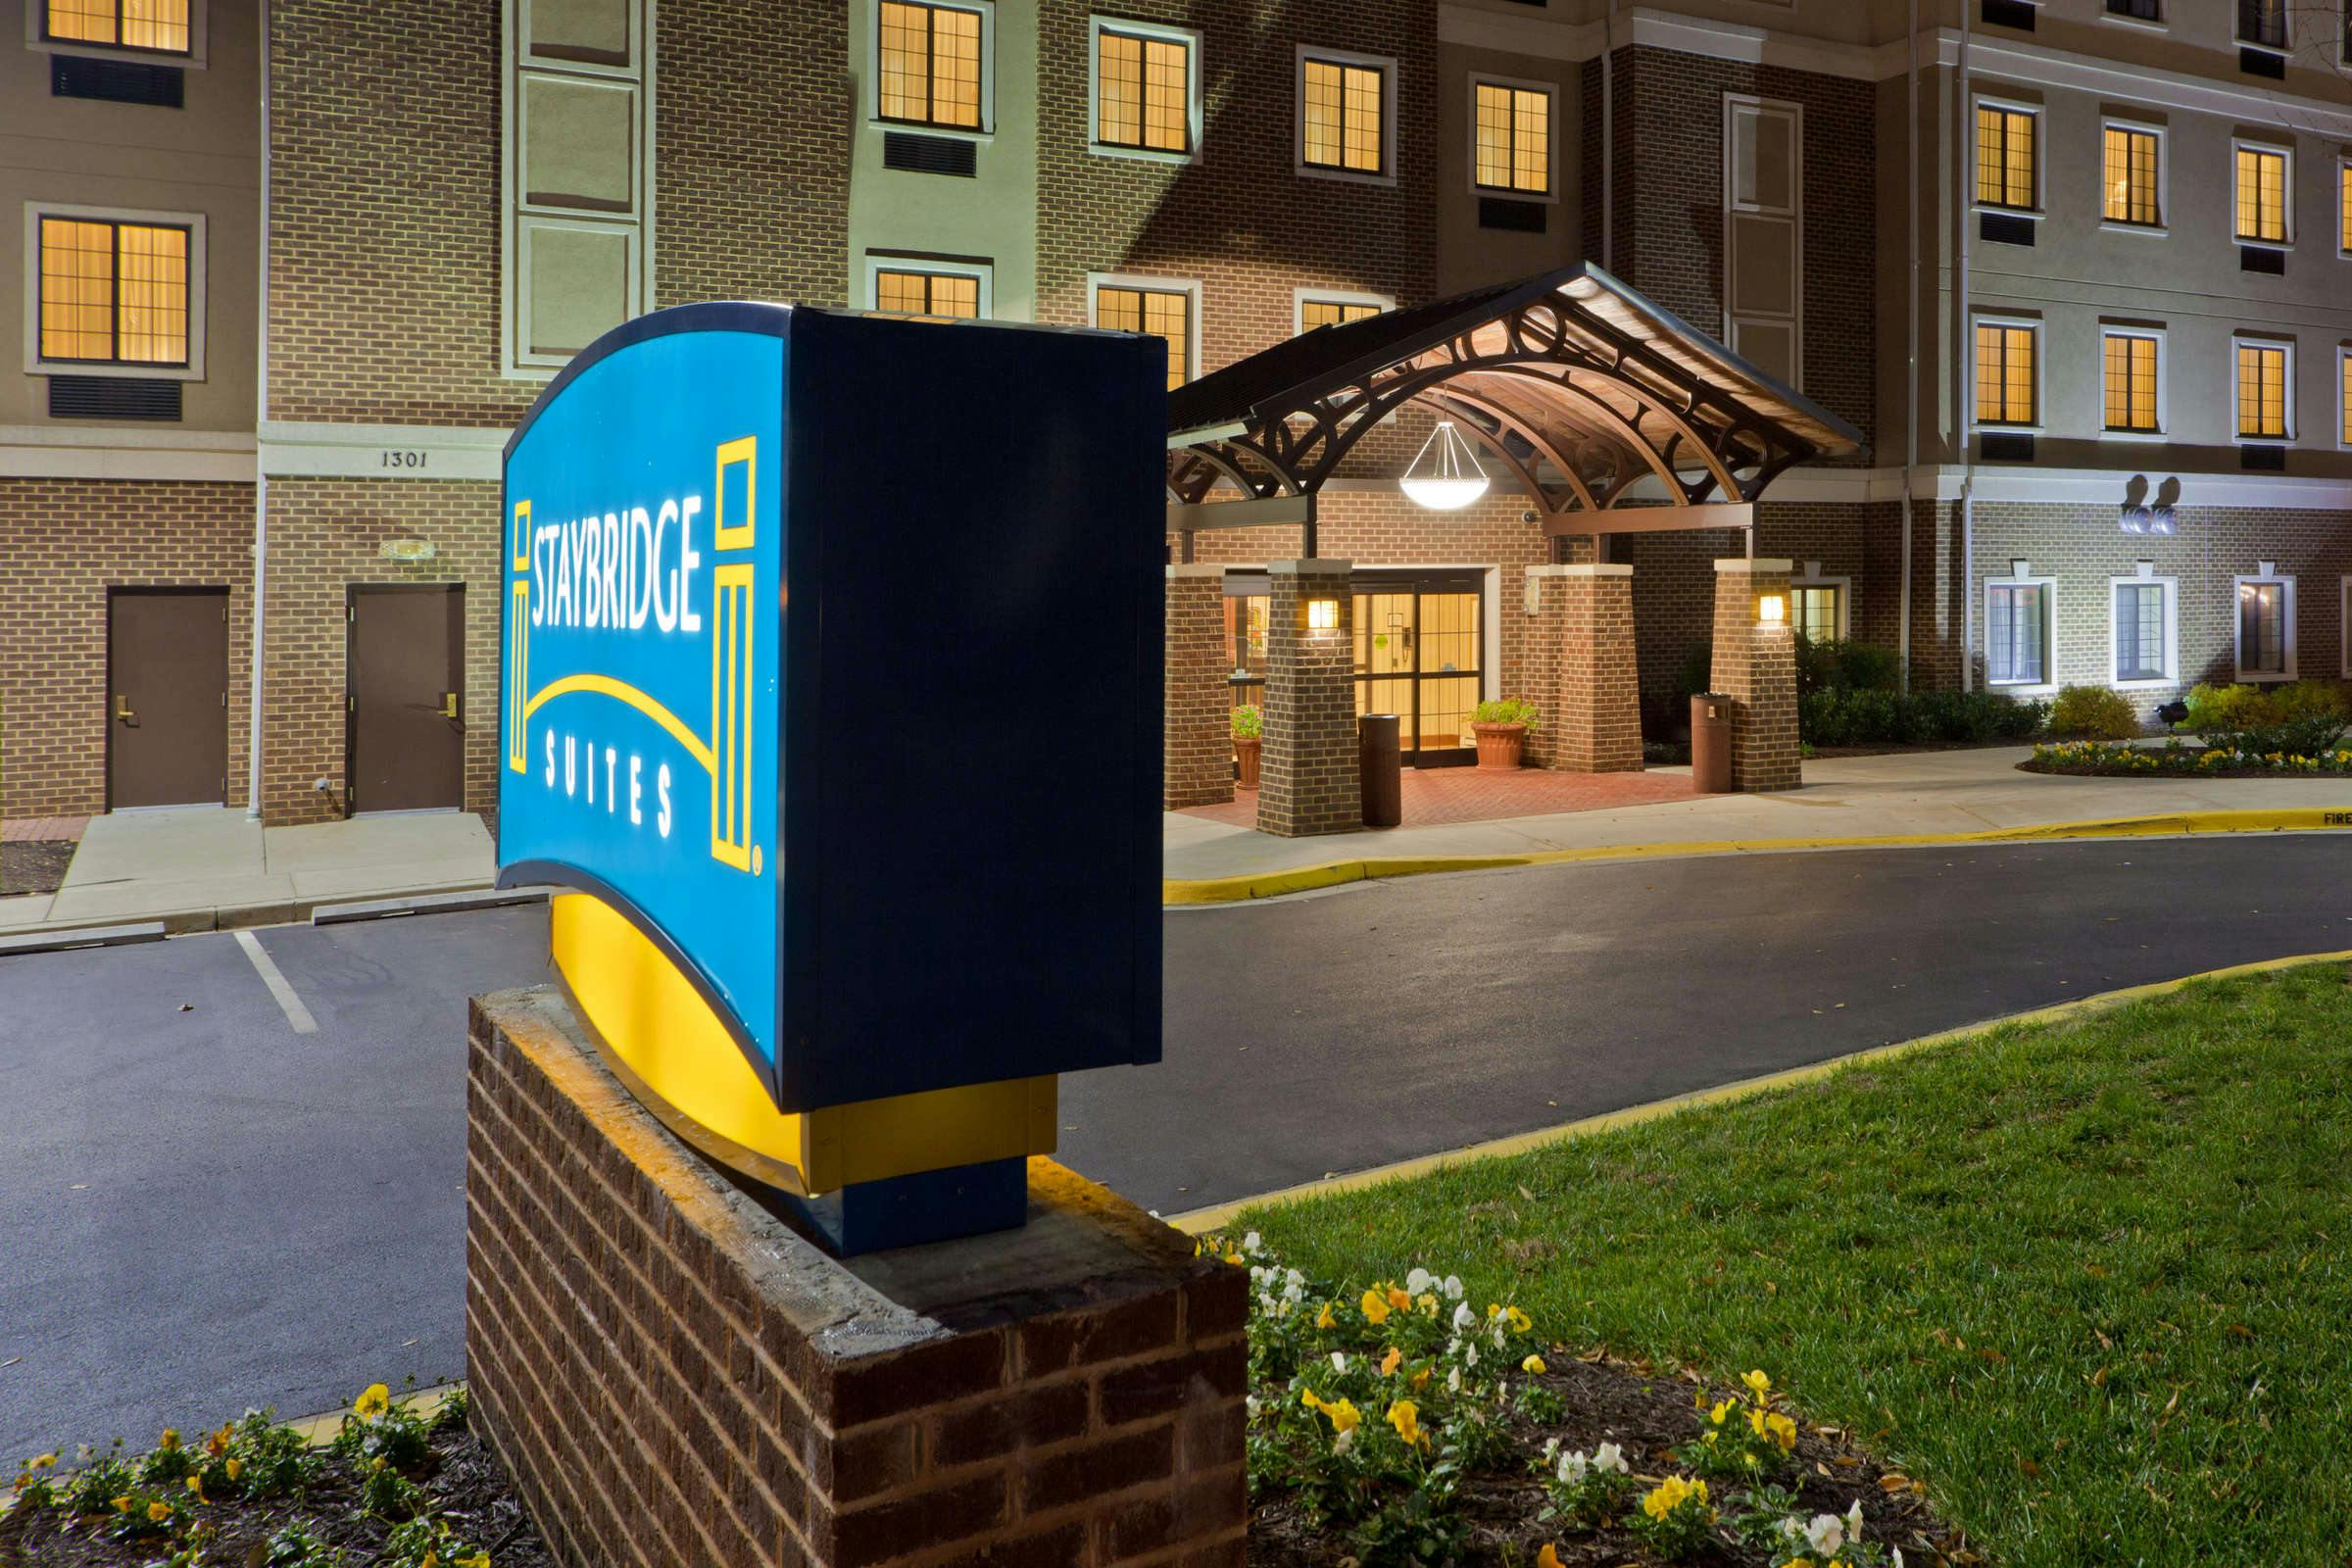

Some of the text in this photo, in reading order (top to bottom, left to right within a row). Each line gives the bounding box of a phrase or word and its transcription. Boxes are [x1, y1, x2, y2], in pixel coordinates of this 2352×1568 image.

[382, 452, 427, 467] 1301
[532, 495, 702, 633] STAYBRIDGE
[545, 728, 672, 839] SUITES
[2324, 812, 2352, 824] FIRE
